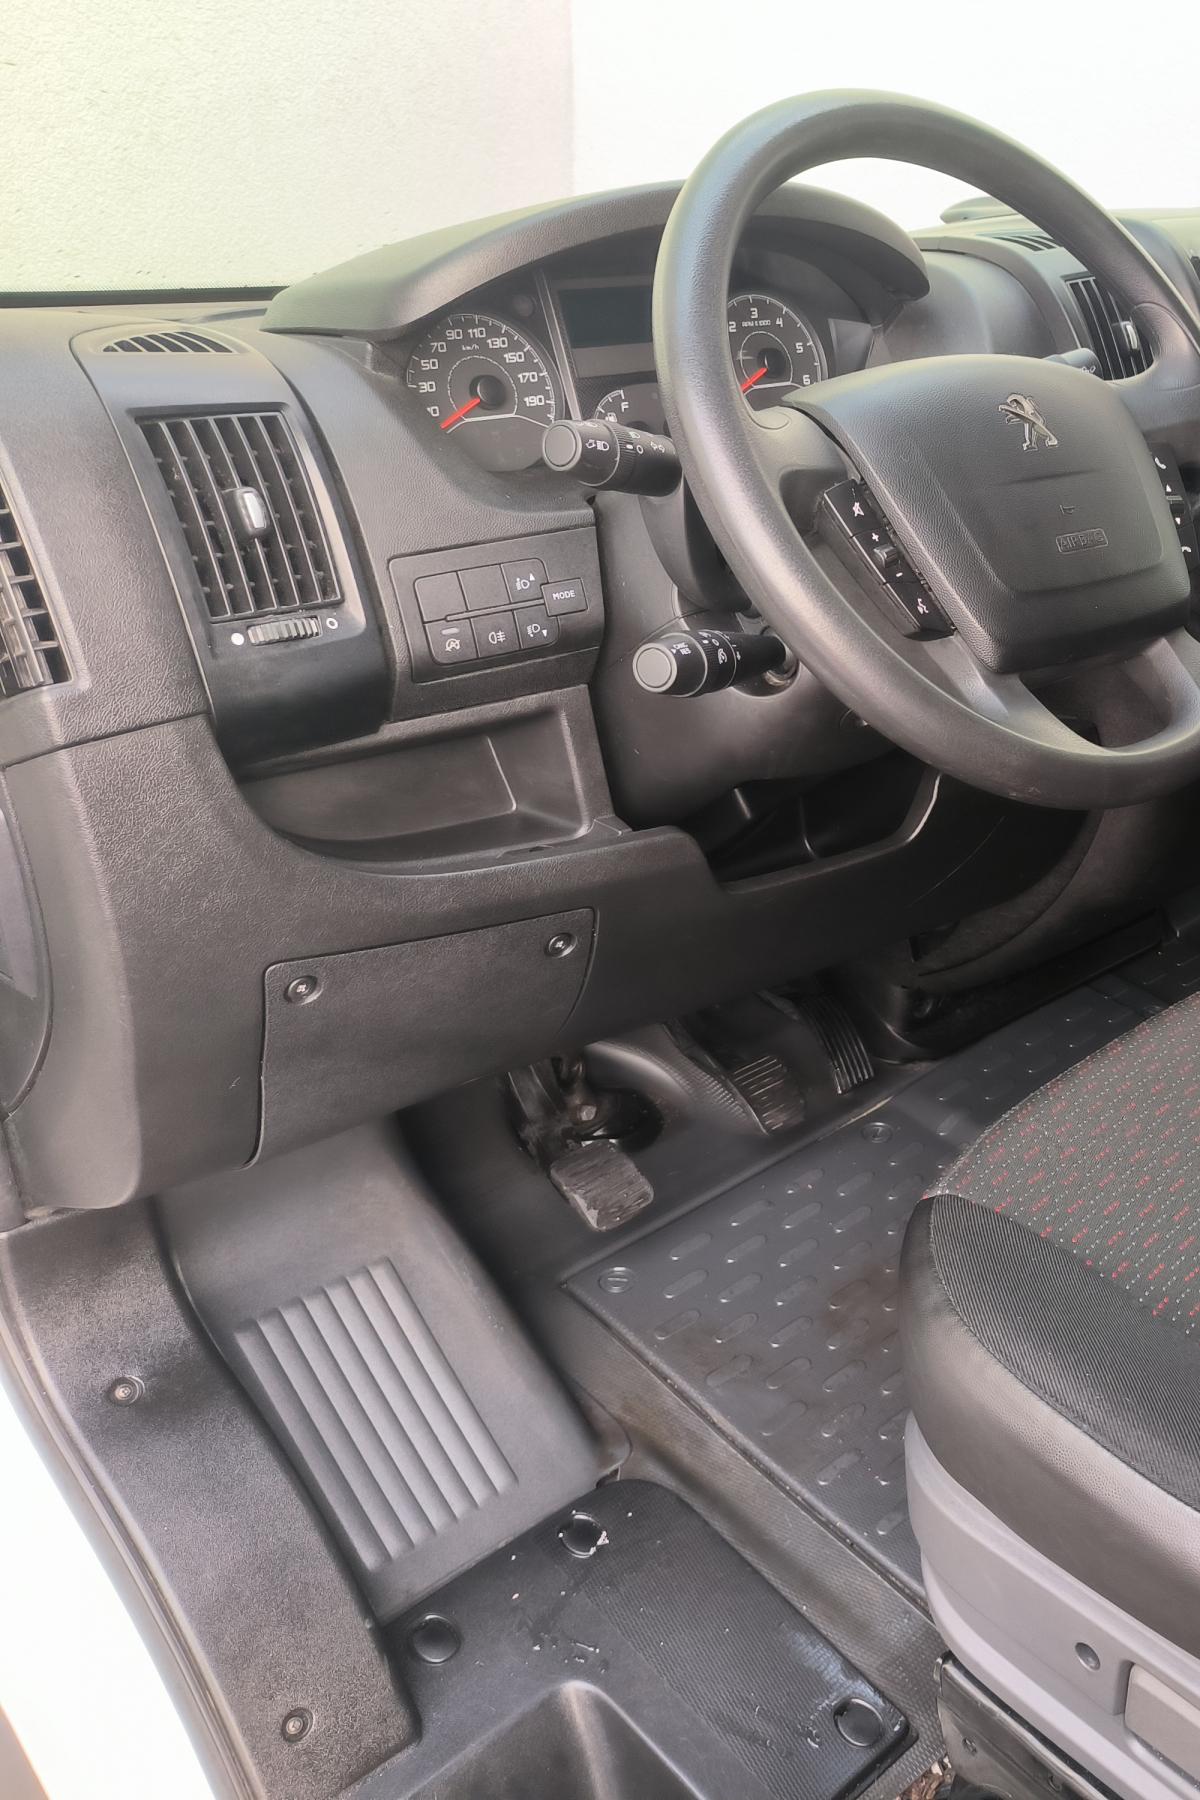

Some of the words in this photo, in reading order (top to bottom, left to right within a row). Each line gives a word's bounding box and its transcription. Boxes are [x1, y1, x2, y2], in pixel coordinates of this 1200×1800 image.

[749, 307, 759, 319] 3
[728, 321, 737, 333] 2
[775, 317, 784, 328] 4
[445, 328, 463, 340] 90
[467, 327, 487, 339] 110
[430, 341, 447, 353] 70
[461, 343, 480, 351] km/h
[486, 337, 508, 349] 130
[795, 342, 804, 354] 5
[503, 351, 525, 363] 150
[420, 358, 439, 370] 50
[517, 371, 538, 383] 170
[802, 374, 811, 385] 6
[418, 381, 437, 393] 30
[523, 394, 545, 407] 190
[620, 401, 630, 413] F
[552, 589, 577, 601] MODE
